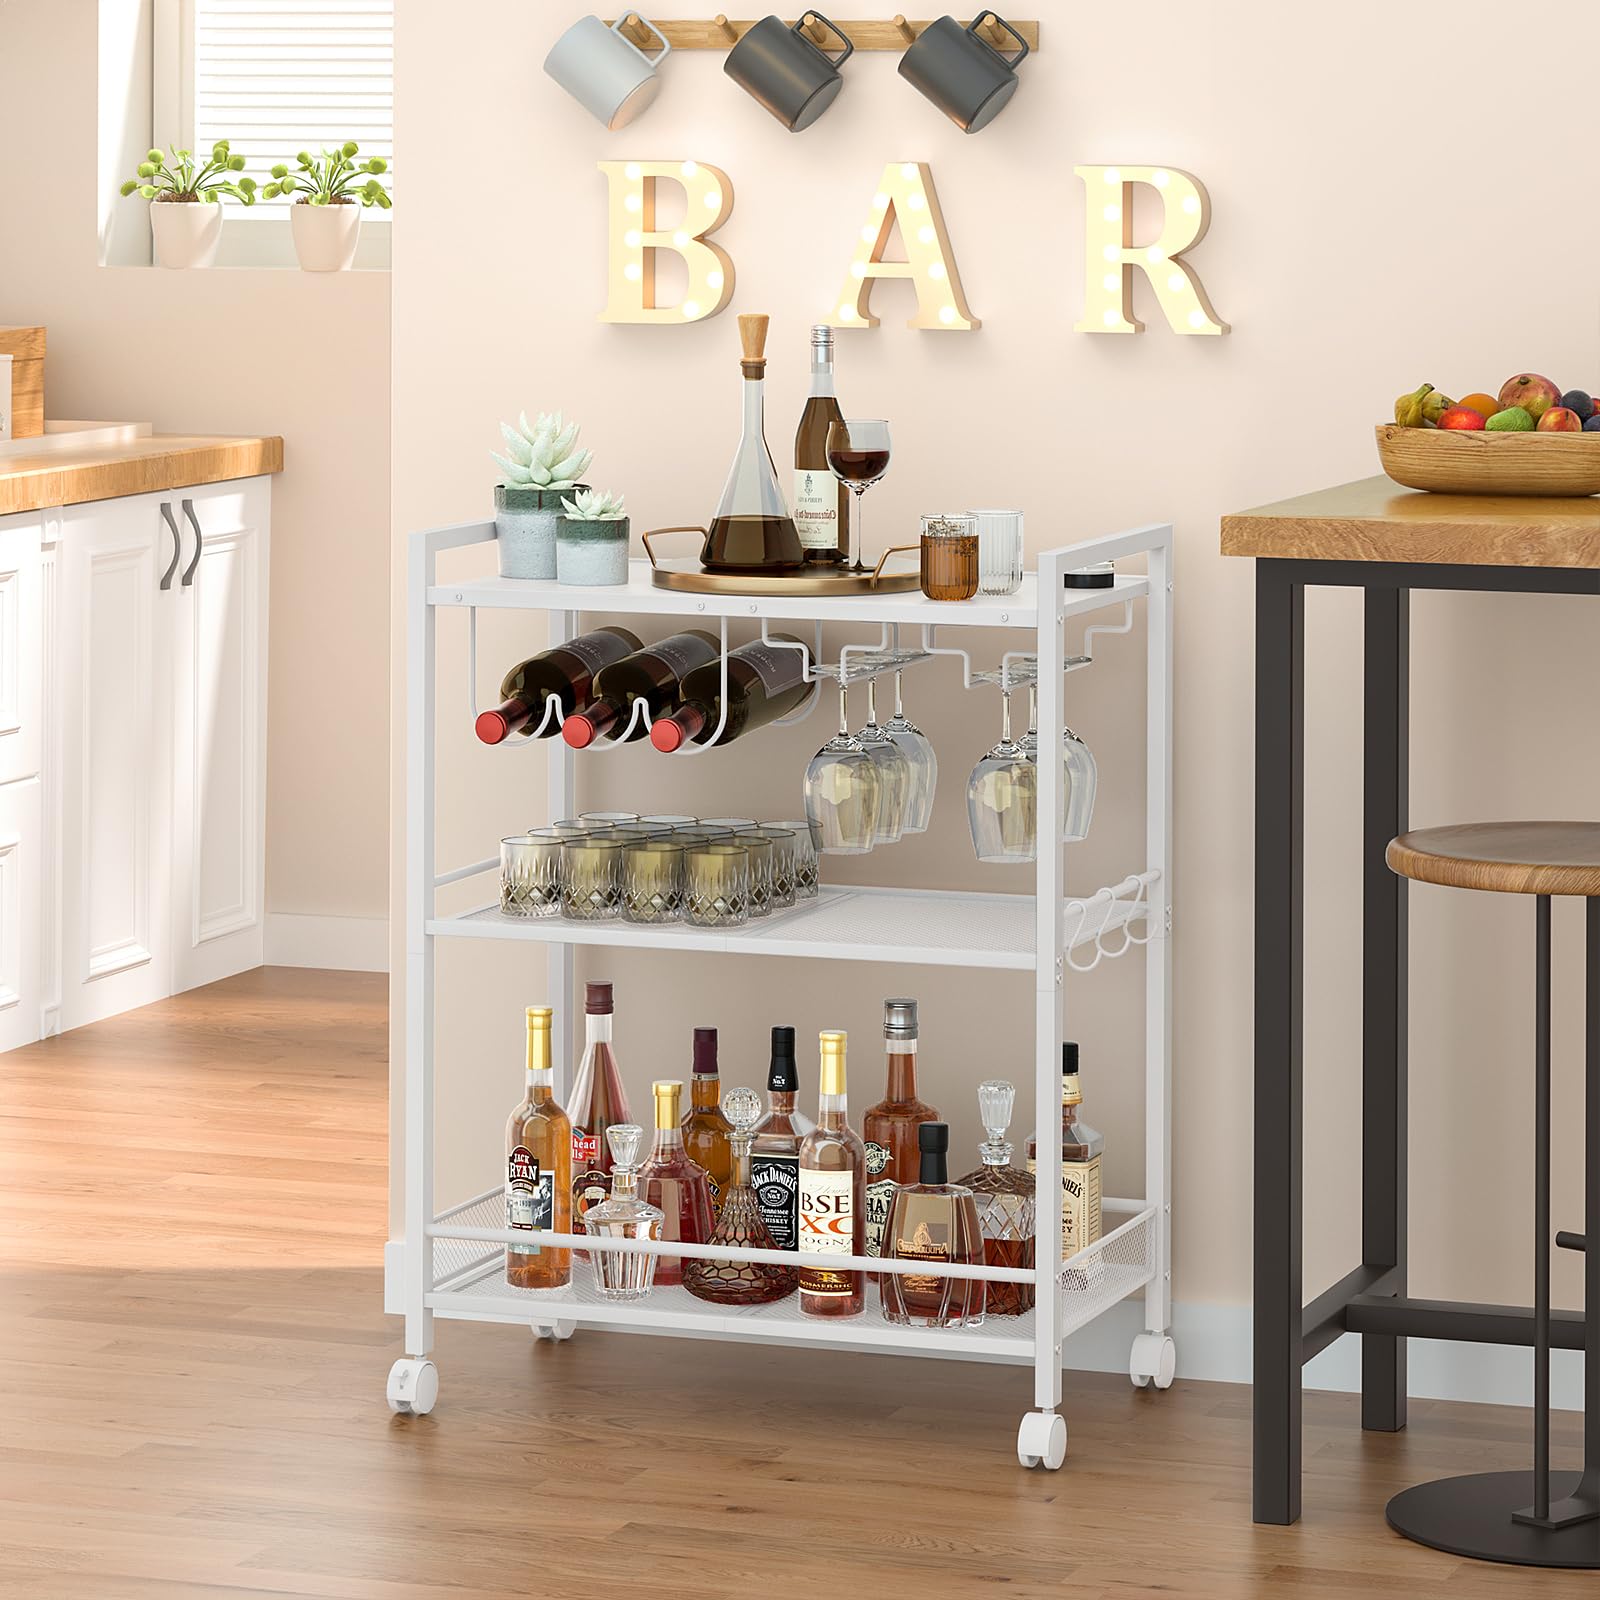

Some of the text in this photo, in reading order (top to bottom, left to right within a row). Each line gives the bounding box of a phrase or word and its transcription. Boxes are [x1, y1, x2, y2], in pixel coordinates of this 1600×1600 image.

[596, 160, 1232, 337] BAR
[514, 1153, 530, 1164] JACK
[509, 1162, 538, 1180] RYAN
[751, 1170, 769, 1190] JACK
[769, 1166, 798, 1193] DANIEL'S
[1062, 1176, 1083, 1199] NIEL'S
[759, 1205, 789, 1215] Tennessee
[801, 1192, 850, 1213] BSE
[761, 1217, 789, 1225] HISKEY
